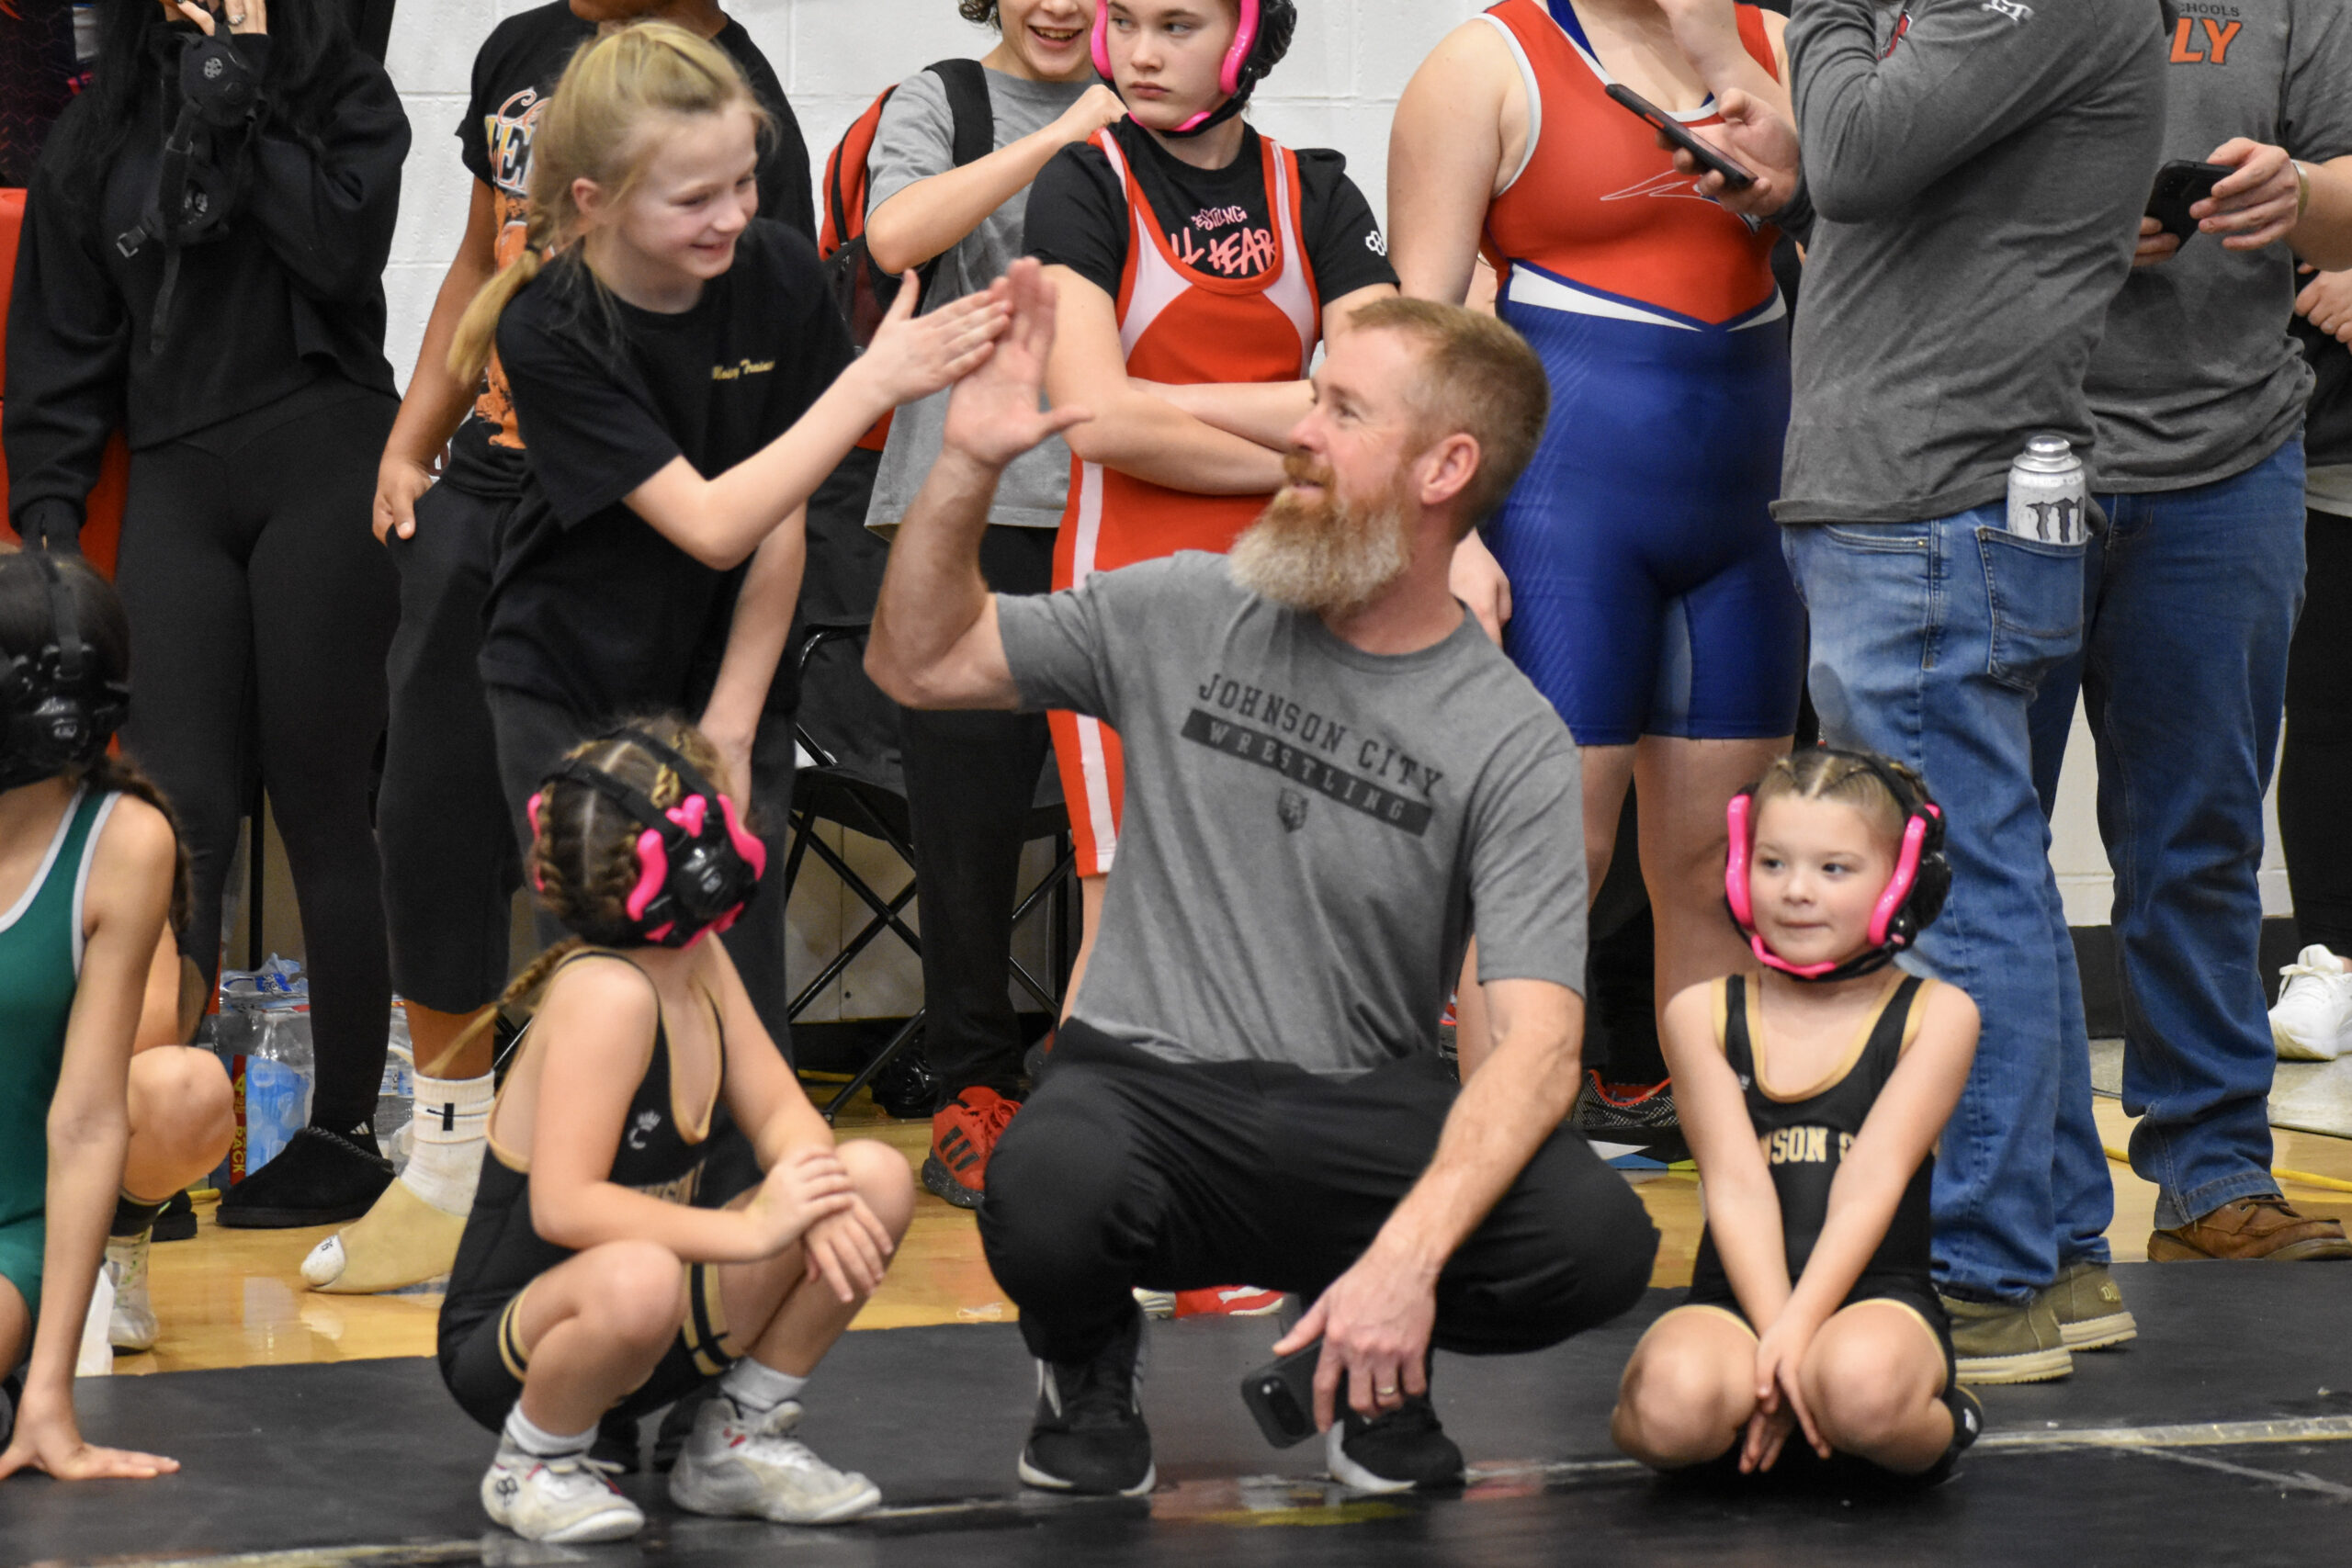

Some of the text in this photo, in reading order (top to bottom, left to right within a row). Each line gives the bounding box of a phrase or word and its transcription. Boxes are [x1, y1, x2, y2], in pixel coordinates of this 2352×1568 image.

[2169, 17, 2243, 65] LY
[1206, 227, 1276, 276] HEAR
[1198, 672, 1443, 797] JOHNSON CITY
[1208, 719, 1406, 821] WRESTLING
